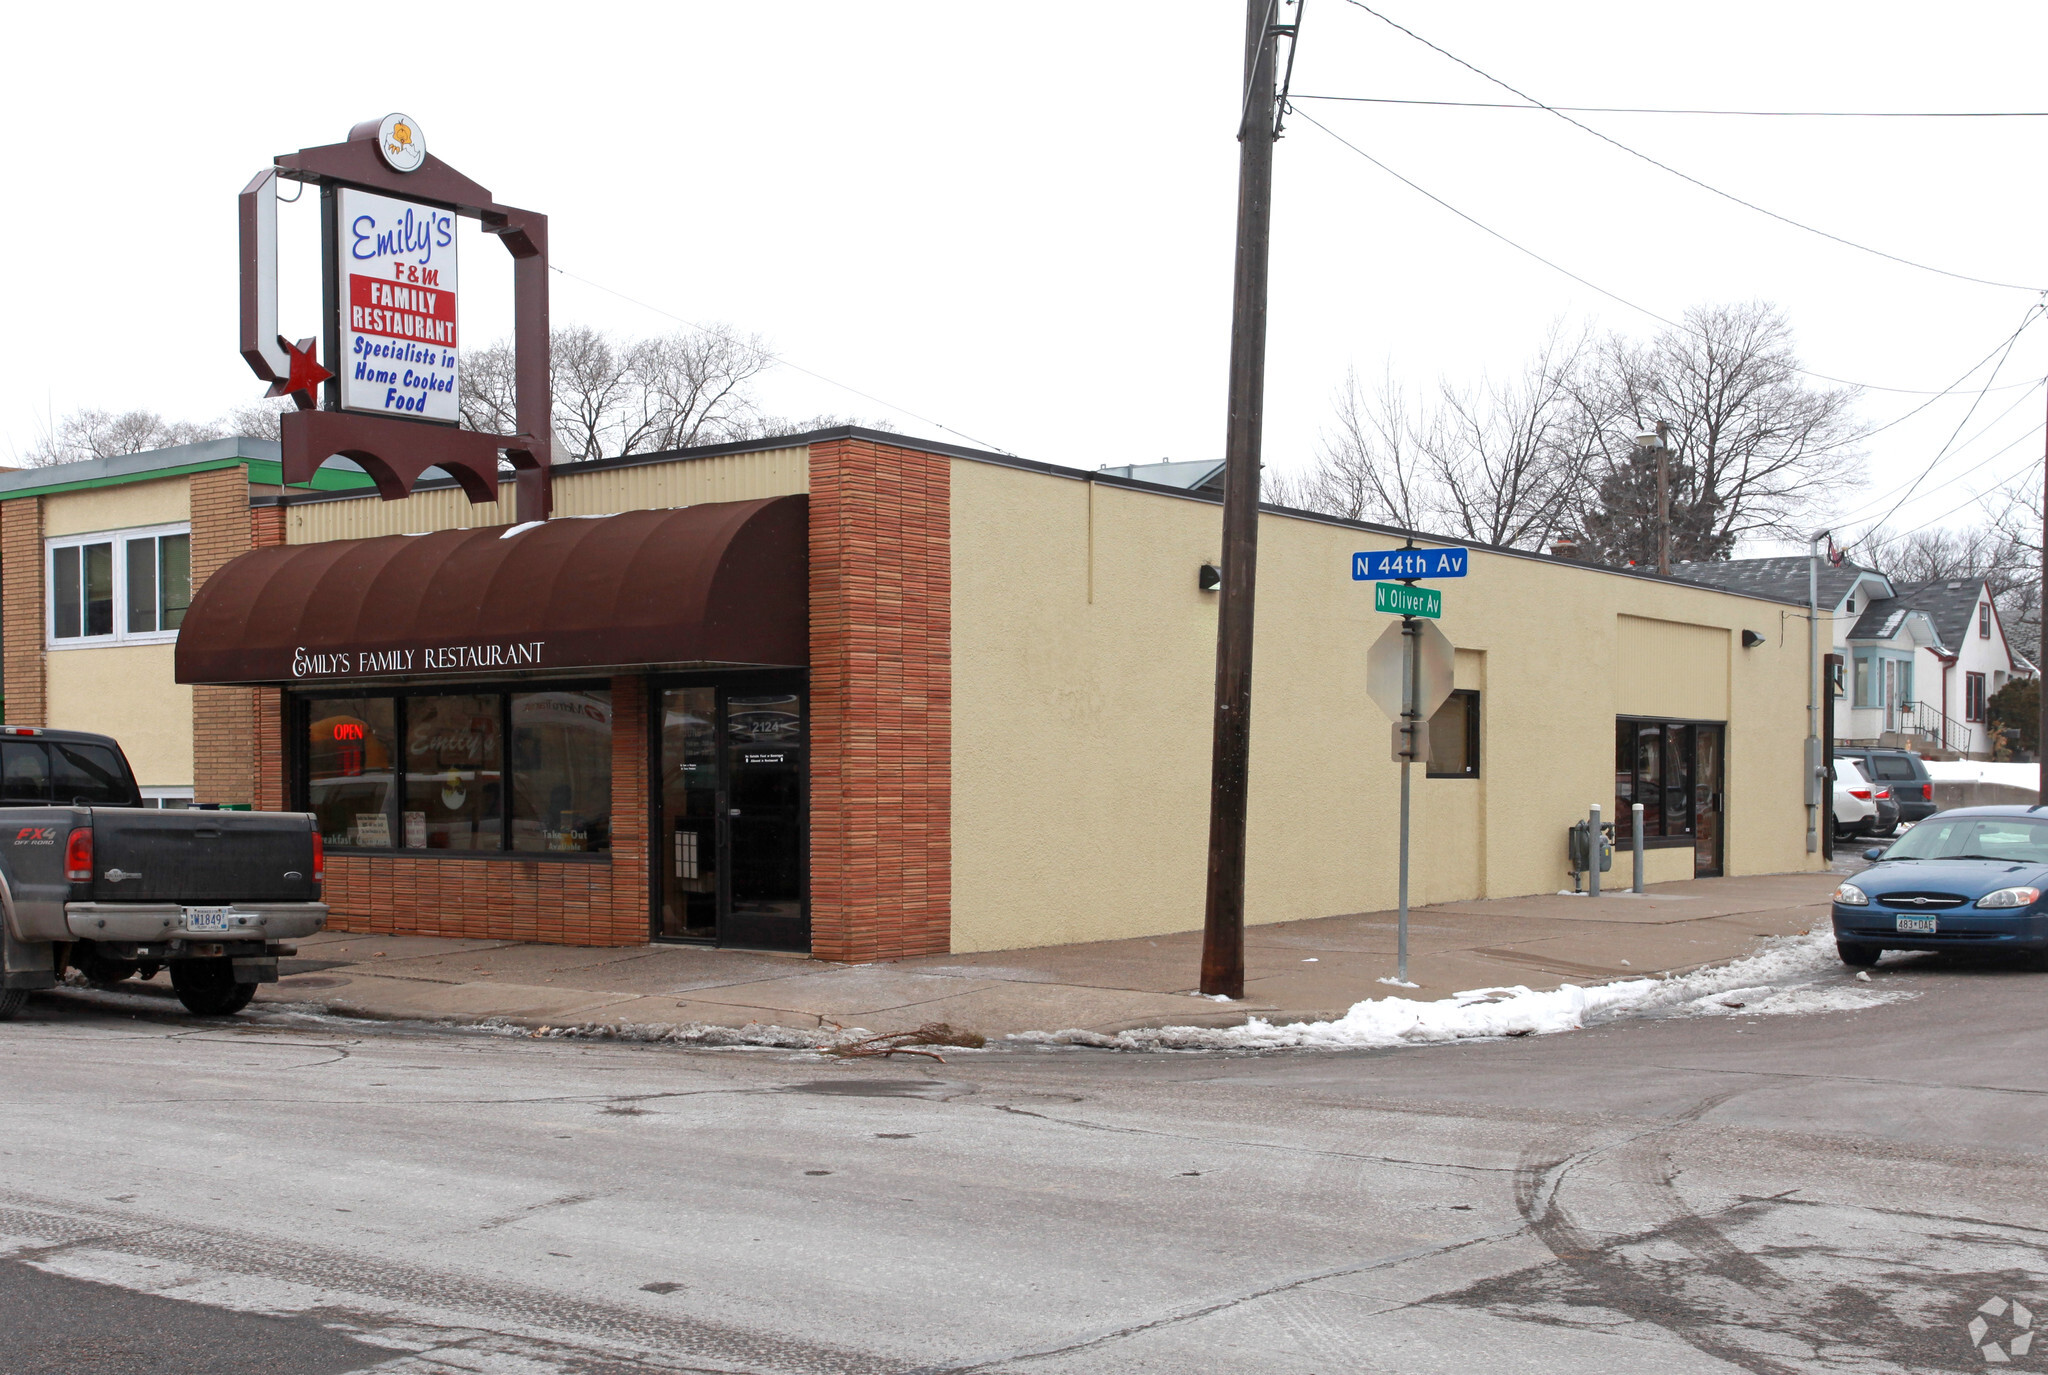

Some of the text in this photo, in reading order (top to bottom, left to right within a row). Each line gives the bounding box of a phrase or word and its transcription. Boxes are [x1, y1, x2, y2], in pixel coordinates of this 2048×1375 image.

[352, 208, 452, 264] Emily's
[371, 282, 437, 315] FAMILY
[353, 305, 454, 343] RESTAURANT
[353, 336, 455, 368] Specialists in
[355, 362, 454, 393] Home Cooked
[385, 387, 427, 413] Food
[1357, 553, 1463, 575] N 44th Av
[1377, 588, 1440, 613] N Oliver Av
[359, 649, 415, 672] FAMILY
[425, 642, 545, 669] RESTAURANT
[334, 724, 364, 740] OPEN
[752, 721, 778, 732] 2124
[16, 827, 56, 840] FX4
[571, 829, 587, 839] Out
[1898, 919, 1913, 929] 483
